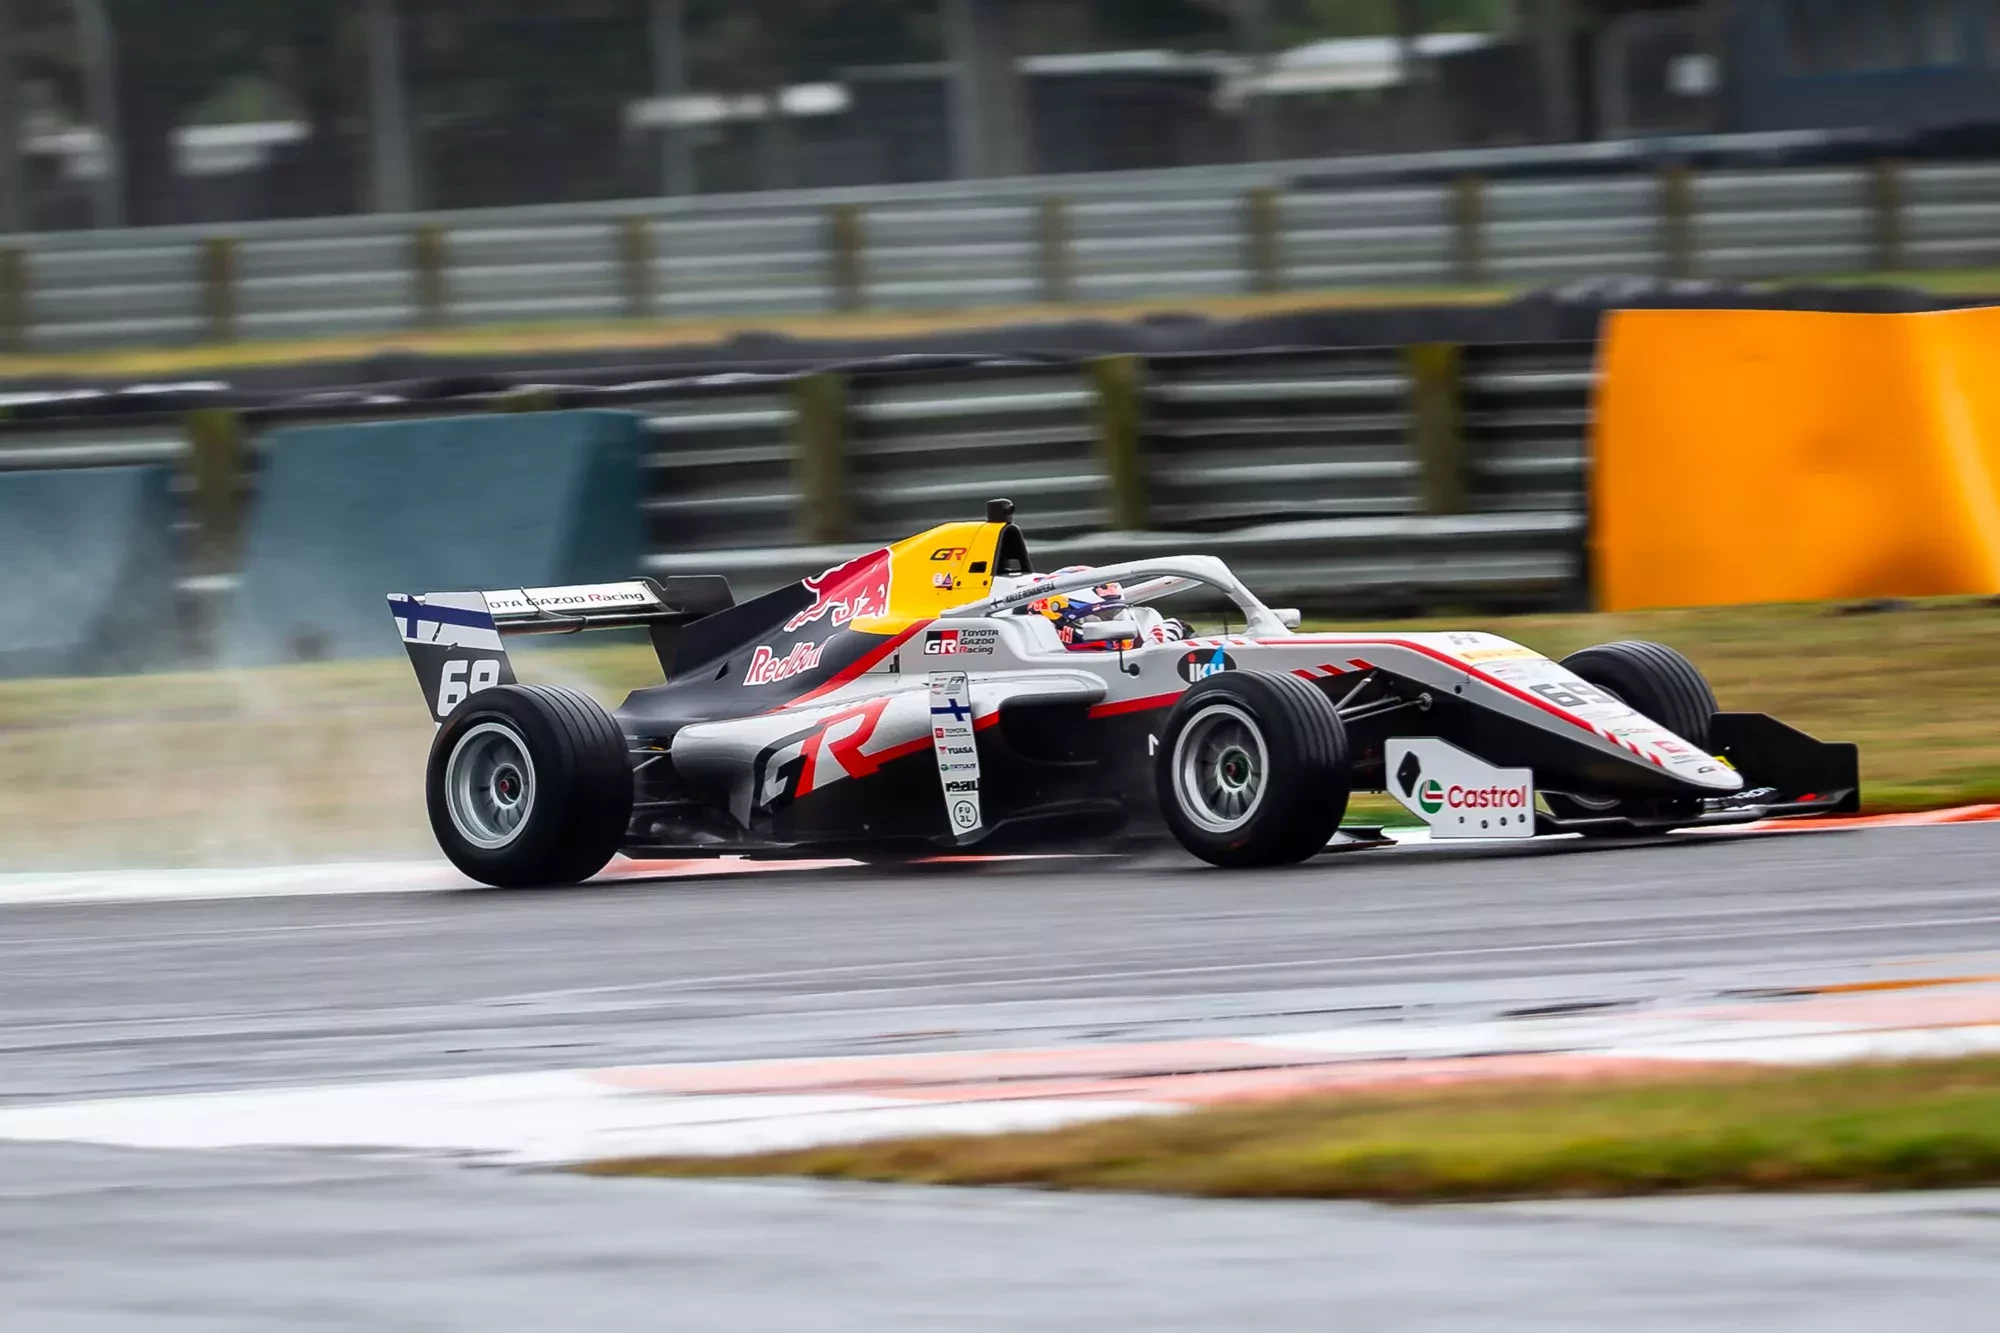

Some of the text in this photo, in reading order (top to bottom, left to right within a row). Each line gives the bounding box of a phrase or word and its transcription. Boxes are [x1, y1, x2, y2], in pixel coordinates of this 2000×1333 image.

[930, 548, 967, 560] GR
[526, 596, 585, 606] GAZOO
[588, 592, 644, 604] Racing
[961, 629, 998, 637] TOYOTA
[924, 639, 957, 655] GR
[960, 646, 993, 655] Racing
[753, 697, 891, 806] GR
[1448, 785, 1526, 808] Castrol
